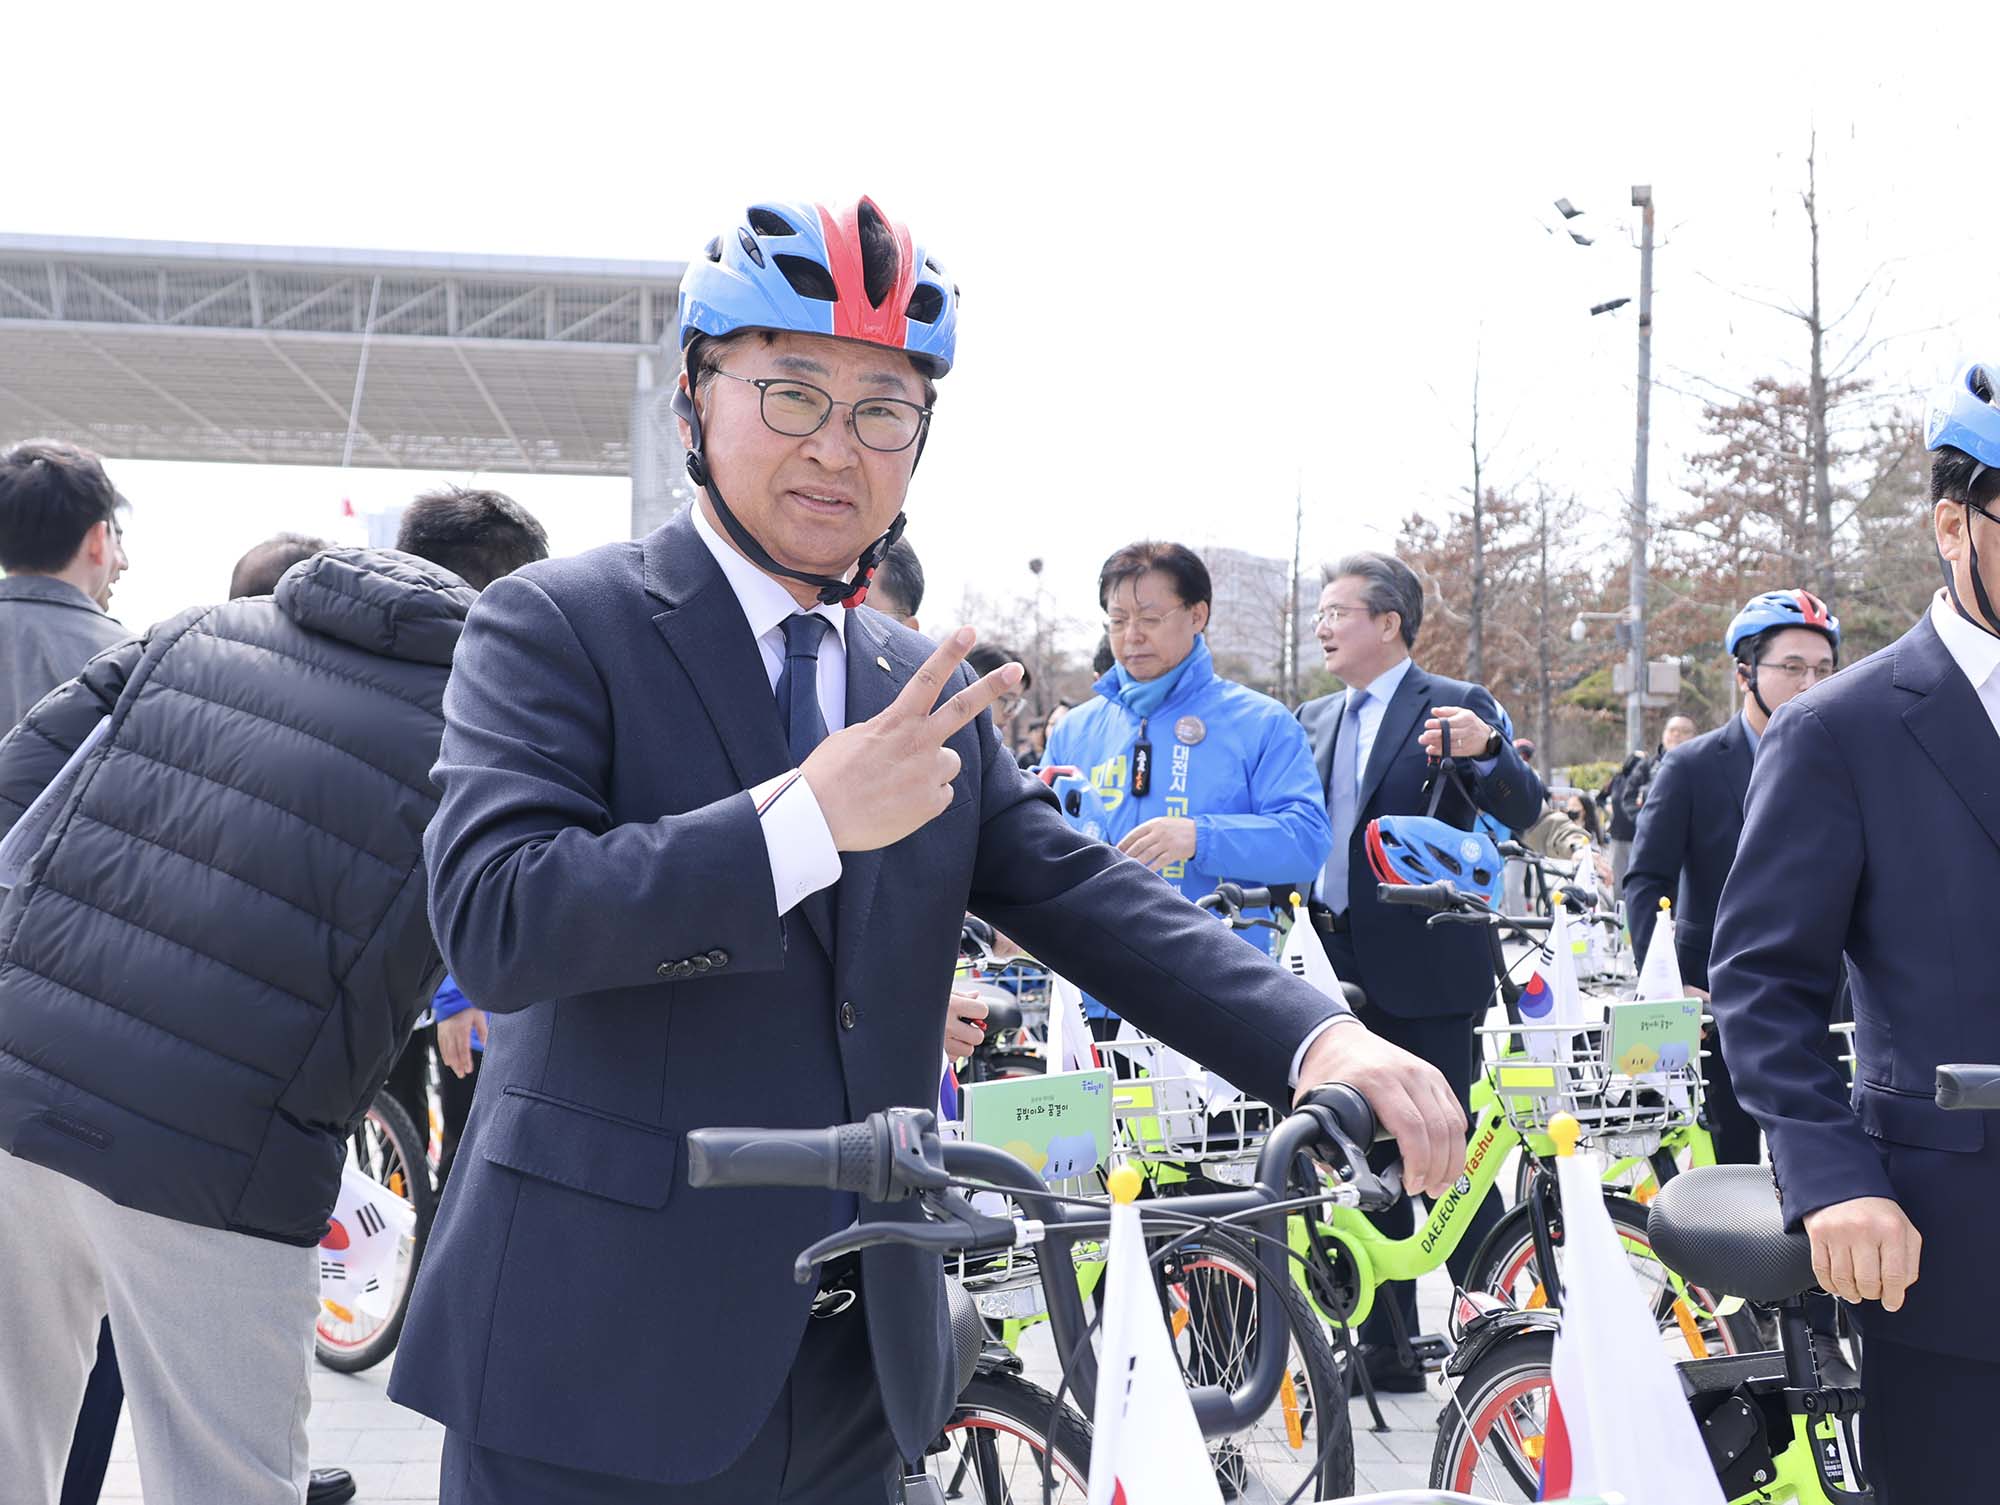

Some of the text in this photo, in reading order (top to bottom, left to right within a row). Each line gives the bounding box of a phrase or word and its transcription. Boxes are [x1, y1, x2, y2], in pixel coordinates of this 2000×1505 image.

[1169, 744, 1189, 793] 대전시
[1421, 1130, 1495, 1254] DAEJEON Tashu
